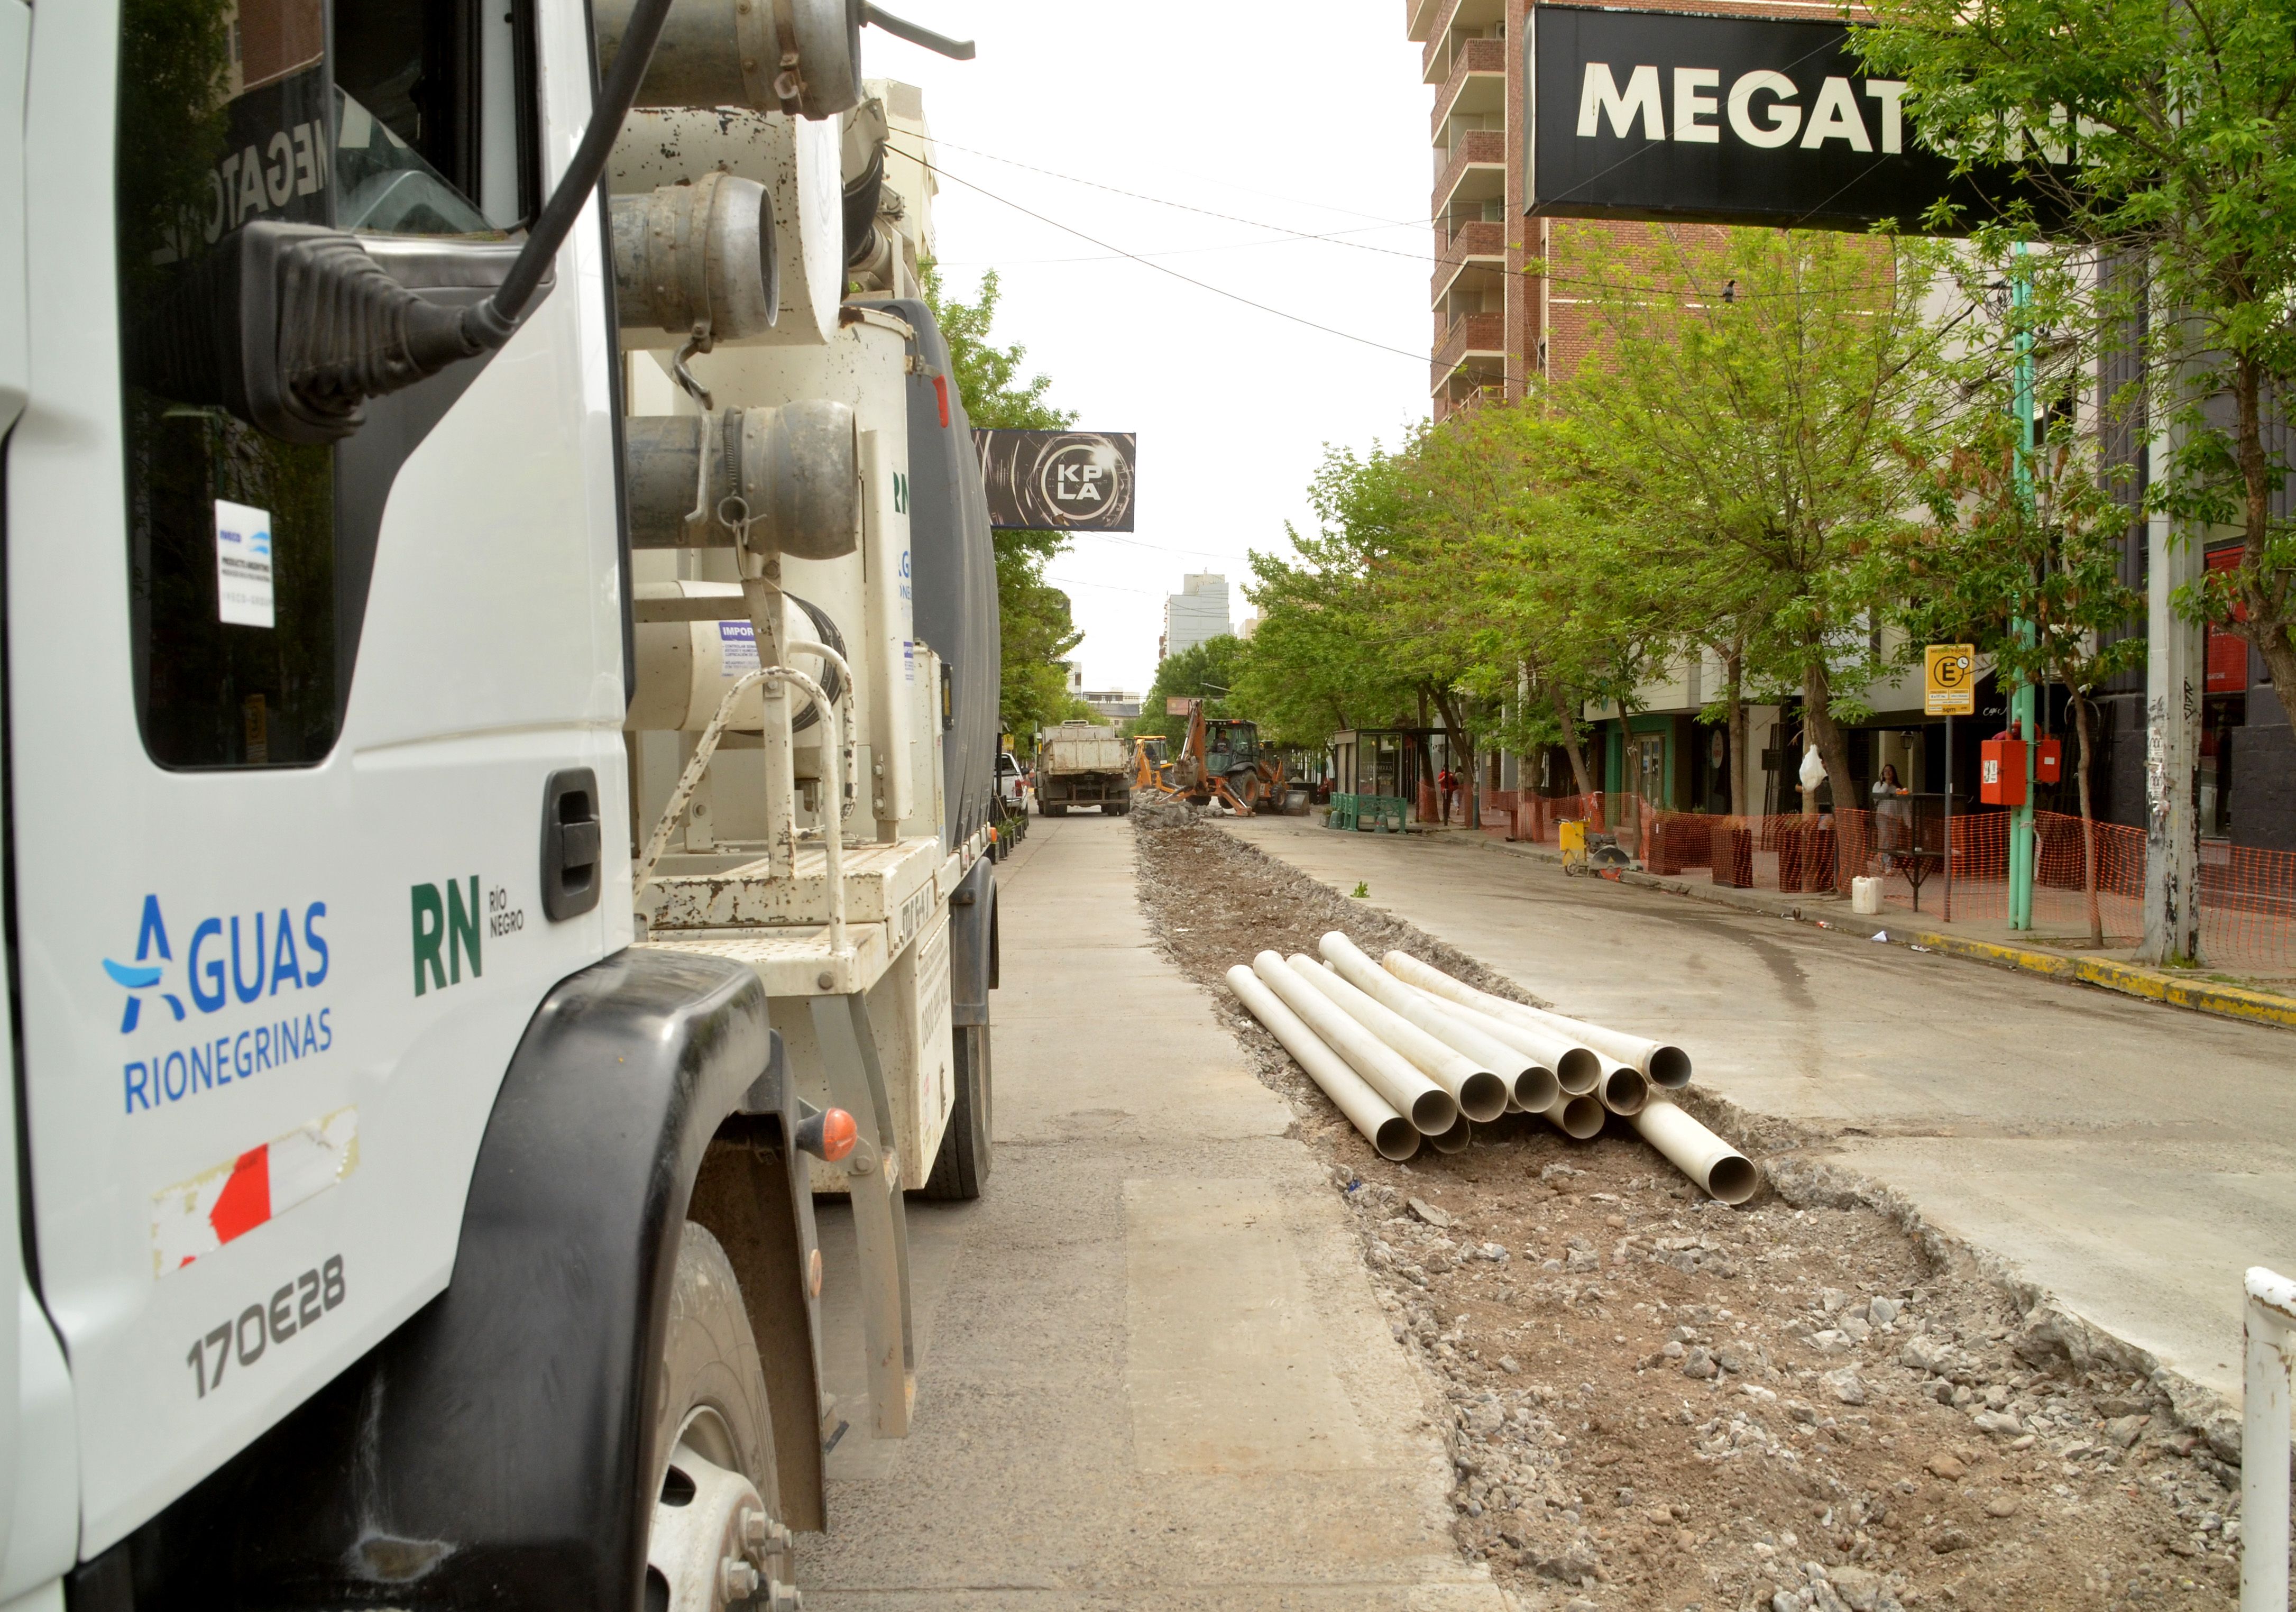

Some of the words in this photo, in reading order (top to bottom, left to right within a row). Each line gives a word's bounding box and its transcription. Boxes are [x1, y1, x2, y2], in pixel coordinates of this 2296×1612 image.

[1058, 464, 1103, 482] KP
[1058, 482, 1101, 500] LA
[1942, 663, 1955, 681] E
[489, 885, 507, 913] RÍO
[411, 875, 482, 997] RN
[490, 909, 524, 938] NEGRO
[102, 893, 329, 1035] AGUAS
[123, 1007, 332, 1115] RIONEGRINAS
[187, 1252, 346, 1400] 170E28
